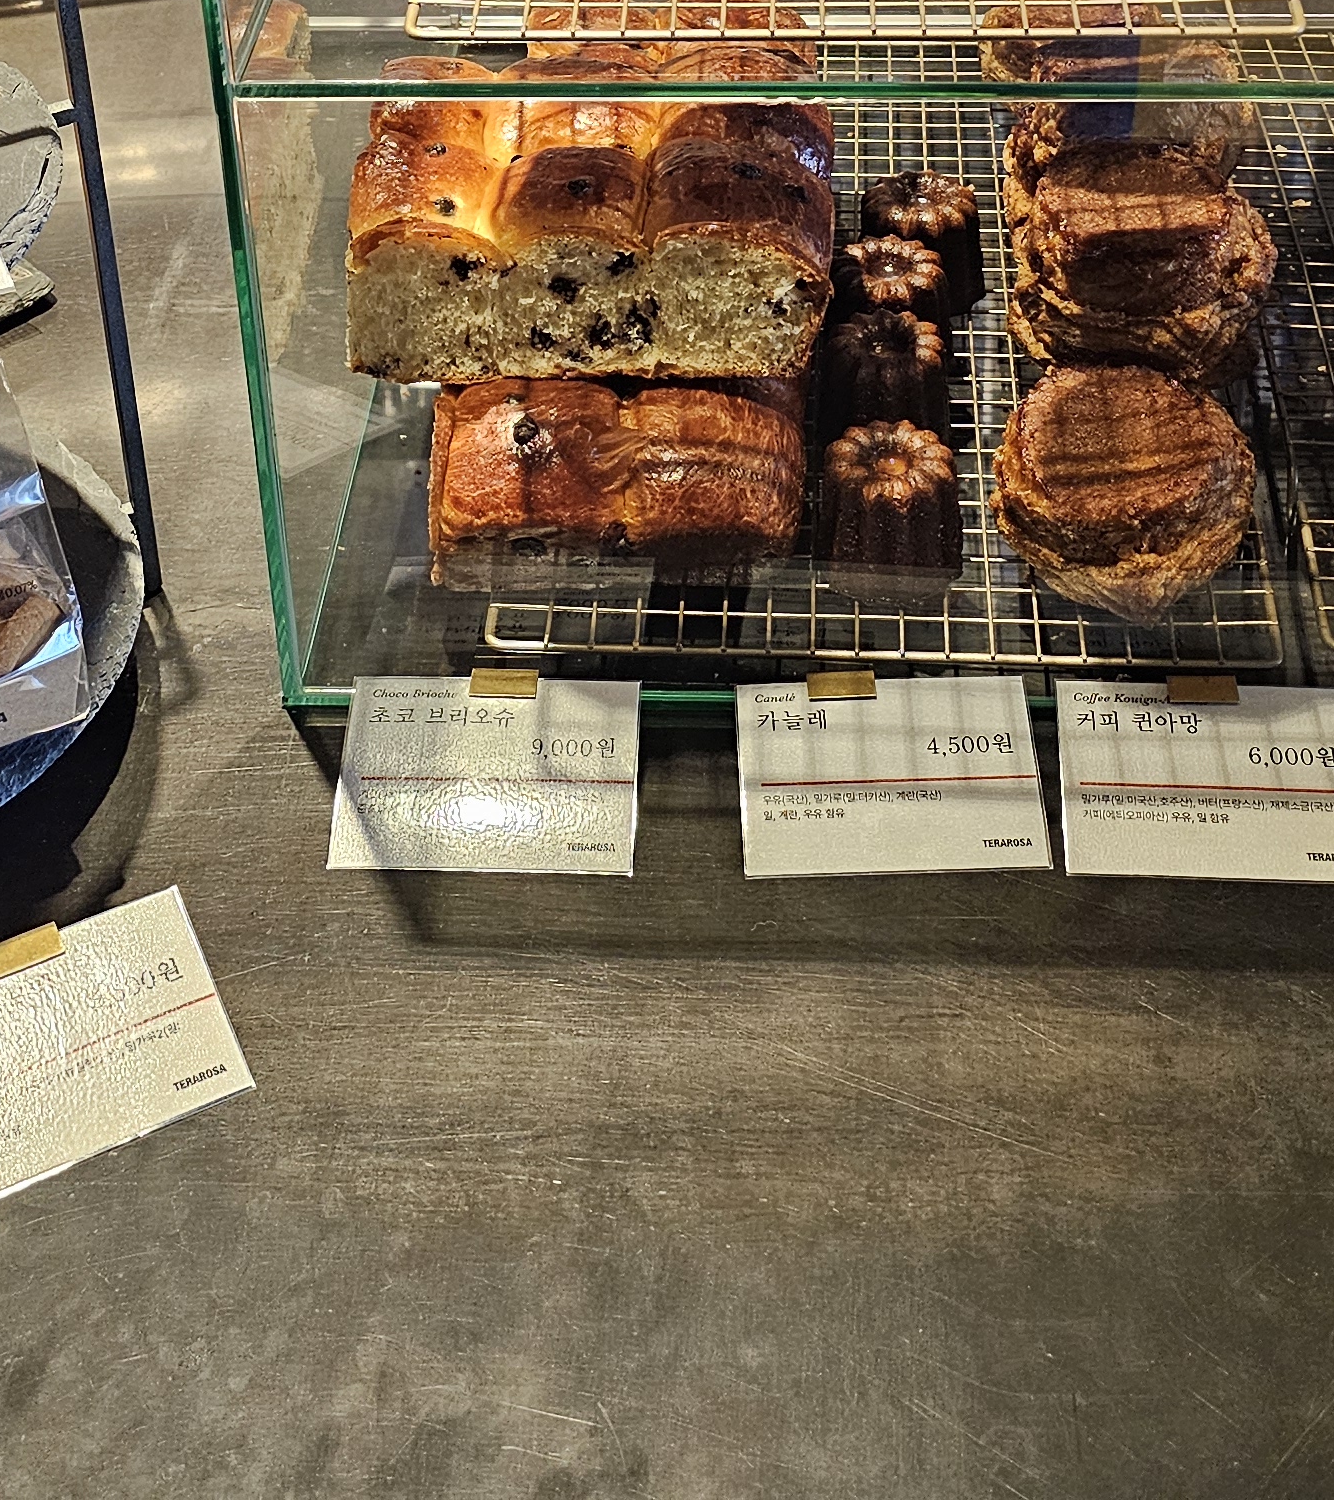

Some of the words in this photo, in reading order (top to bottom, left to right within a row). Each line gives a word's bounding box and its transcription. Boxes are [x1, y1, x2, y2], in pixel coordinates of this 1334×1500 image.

[373, 688, 409, 699] Choco
[1073, 692, 1110, 705] Coffee
[369, 706, 416, 724] 초코
[425, 706, 515, 728] 브리오슈
[756, 709, 828, 731] 카늘레
[1077, 710, 1119, 732] 커피
[1132, 711, 1203, 734] 퀸아망
[531, 737, 615, 760] 9,000원
[926, 732, 1014, 757] 4,500원
[982, 838, 1033, 848] TERAROSA
[172, 1063, 227, 1092] TERAROSA
